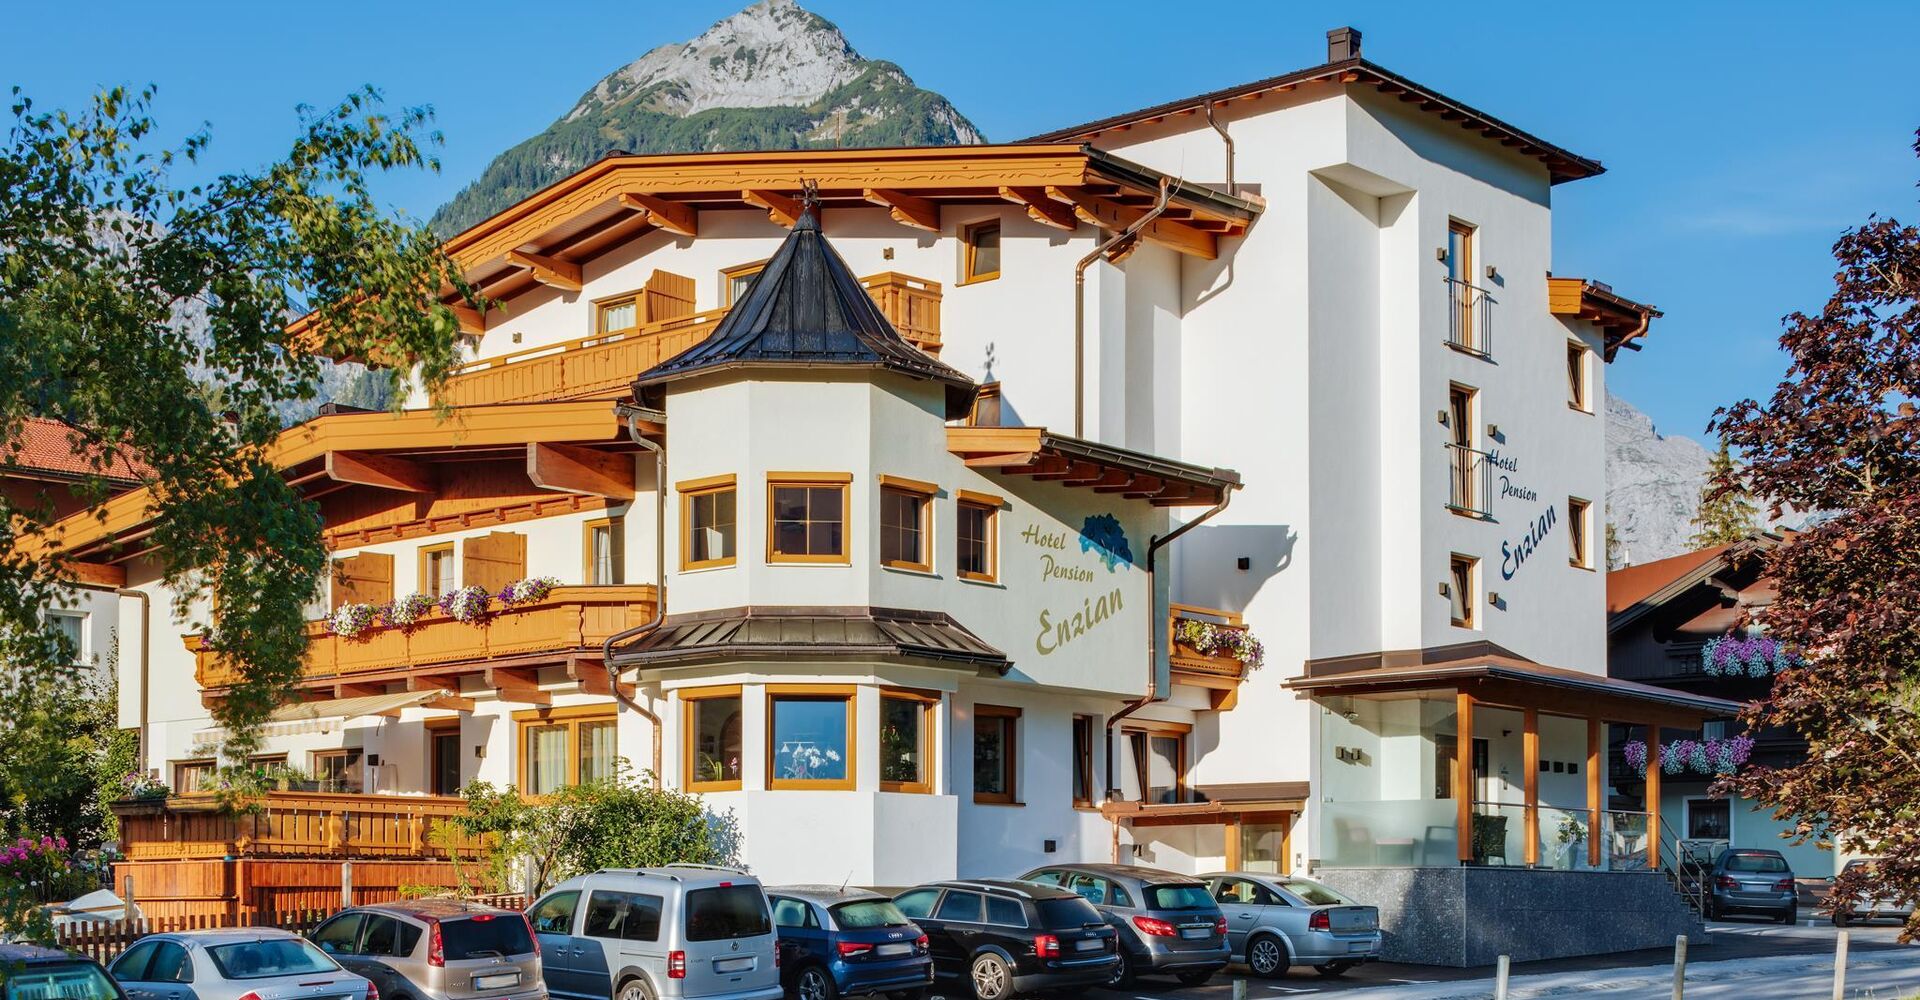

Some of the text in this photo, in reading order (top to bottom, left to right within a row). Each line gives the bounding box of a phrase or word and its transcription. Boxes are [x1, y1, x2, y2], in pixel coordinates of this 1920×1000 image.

[1487, 449, 1518, 472] Hotel
[1499, 475, 1537, 502] Pension
[1021, 524, 1066, 550] Hotel
[1501, 505, 1557, 581] Enzian
[1040, 554, 1094, 582] Pension
[1036, 588, 1124, 656] Enzian
